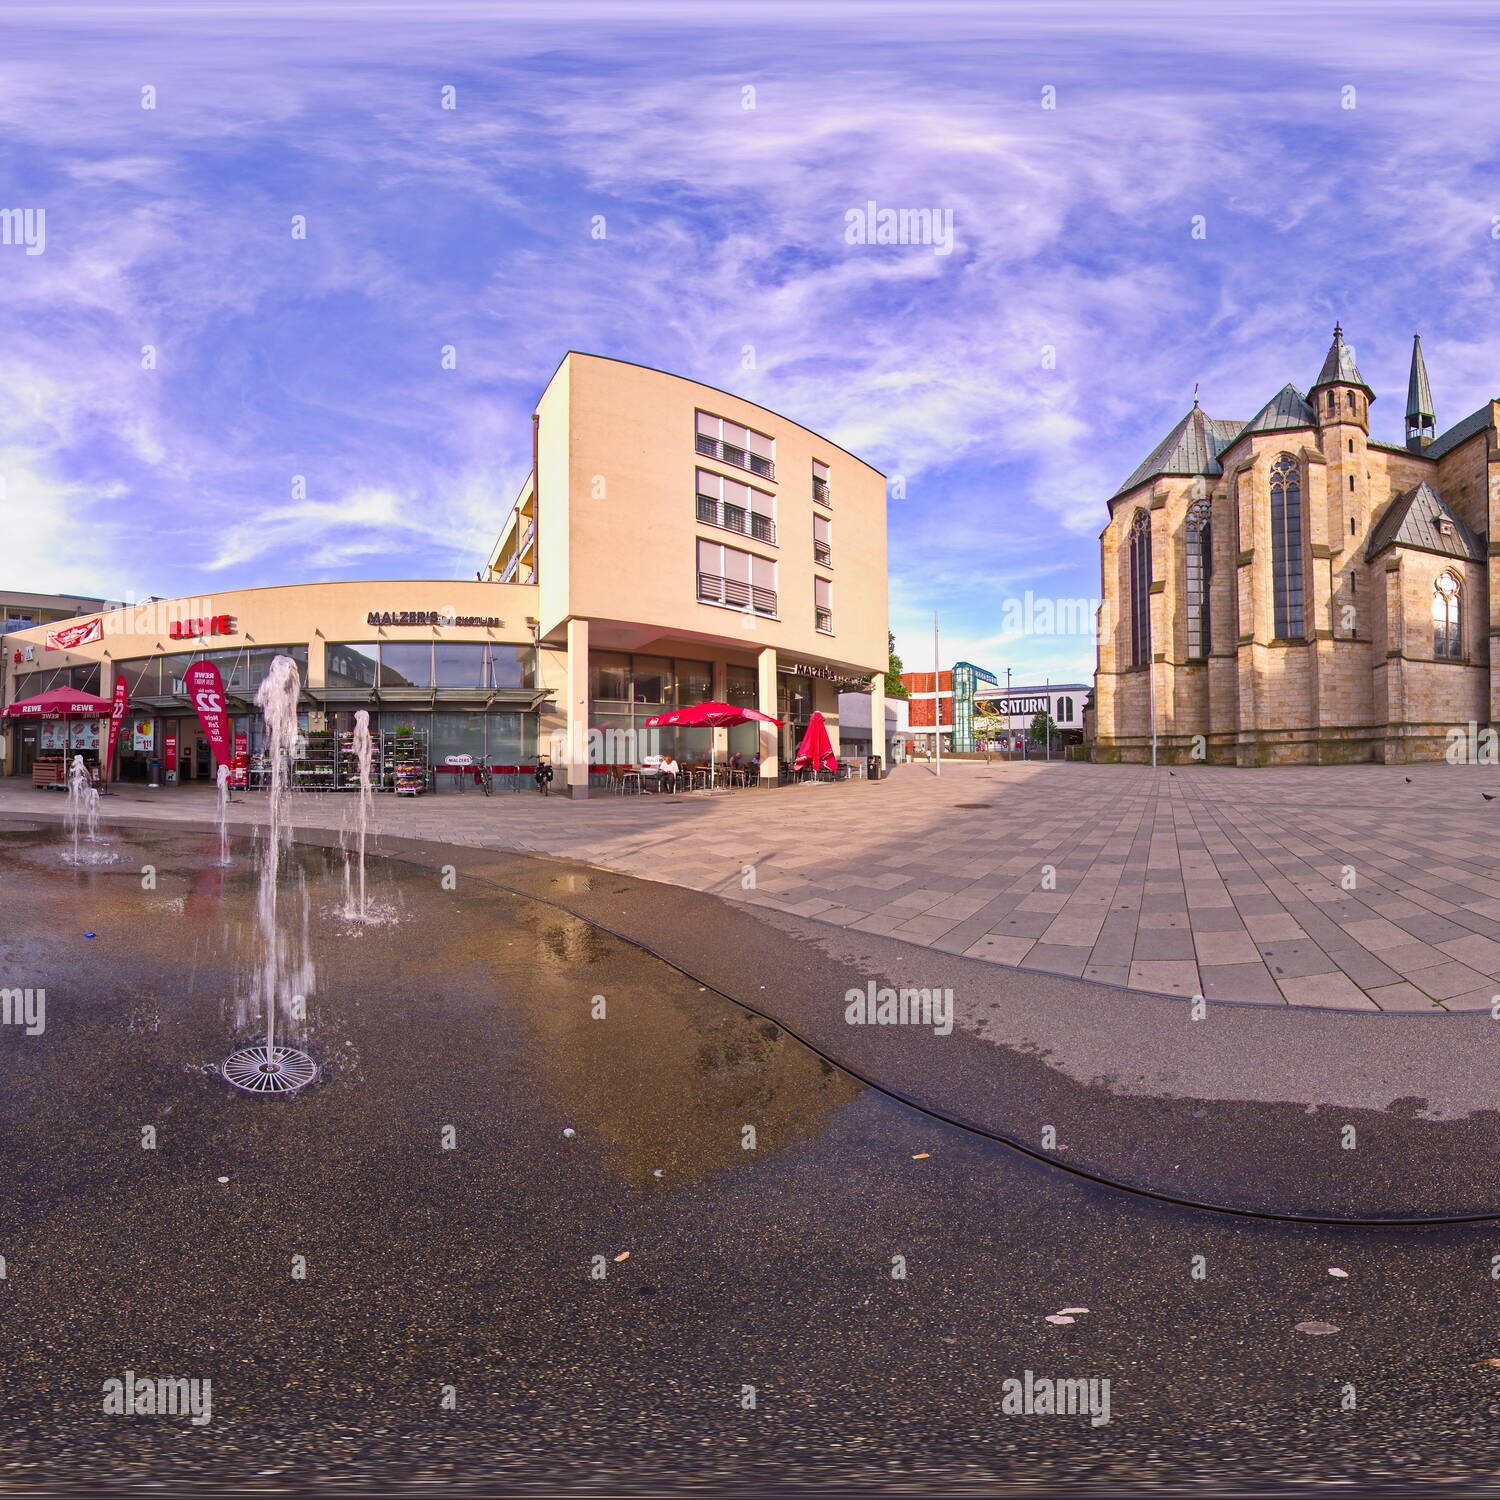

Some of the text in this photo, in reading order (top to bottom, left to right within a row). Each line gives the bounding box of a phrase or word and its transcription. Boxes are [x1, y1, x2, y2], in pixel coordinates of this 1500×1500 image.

[367, 611, 438, 626] MALZER'S
[170, 615, 231, 639] REWE
[22, 704, 42, 713] REWE
[71, 704, 94, 712] REWE
[112, 703, 124, 718] 22
[1000, 697, 1048, 714] SATURN
